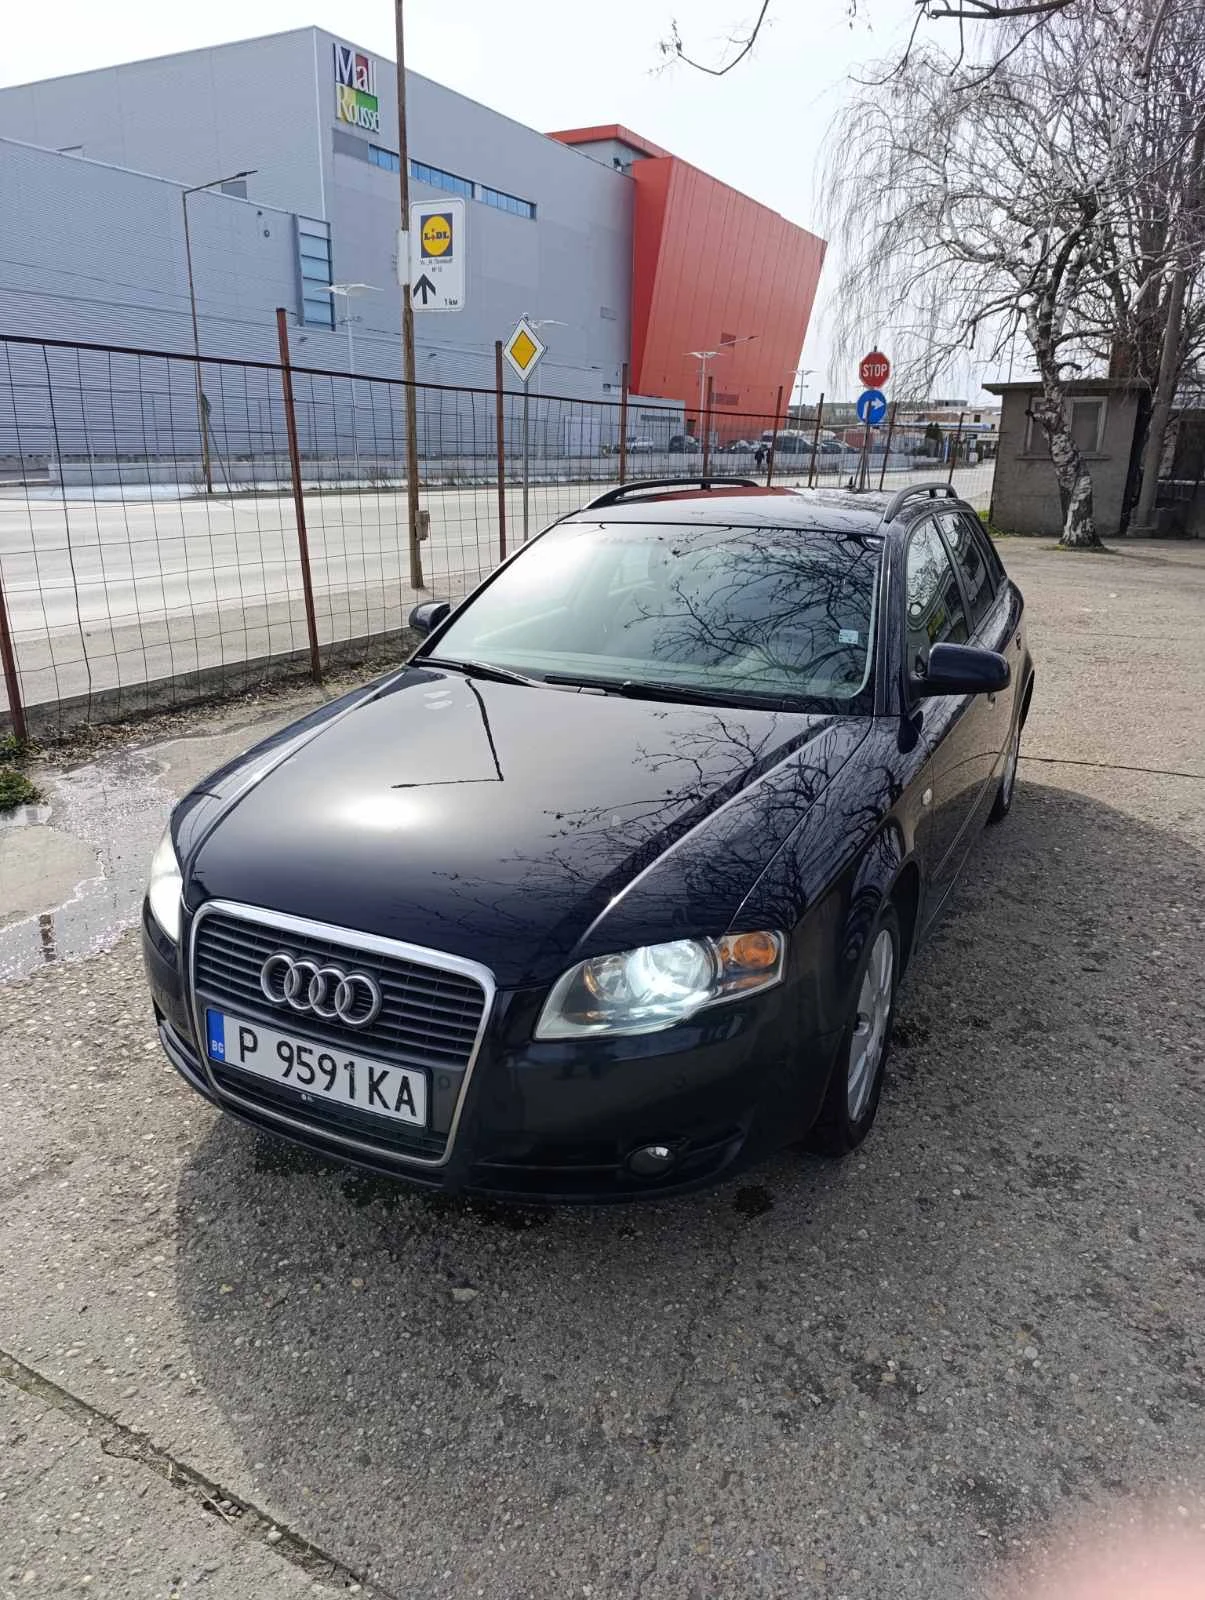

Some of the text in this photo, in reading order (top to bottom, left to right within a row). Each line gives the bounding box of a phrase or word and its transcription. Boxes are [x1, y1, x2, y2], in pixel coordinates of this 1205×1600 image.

[335, 42, 377, 97] Mall
[862, 363, 888, 377] STOP
[211, 1039, 225, 1054] BG
[239, 1025, 259, 1063] P
